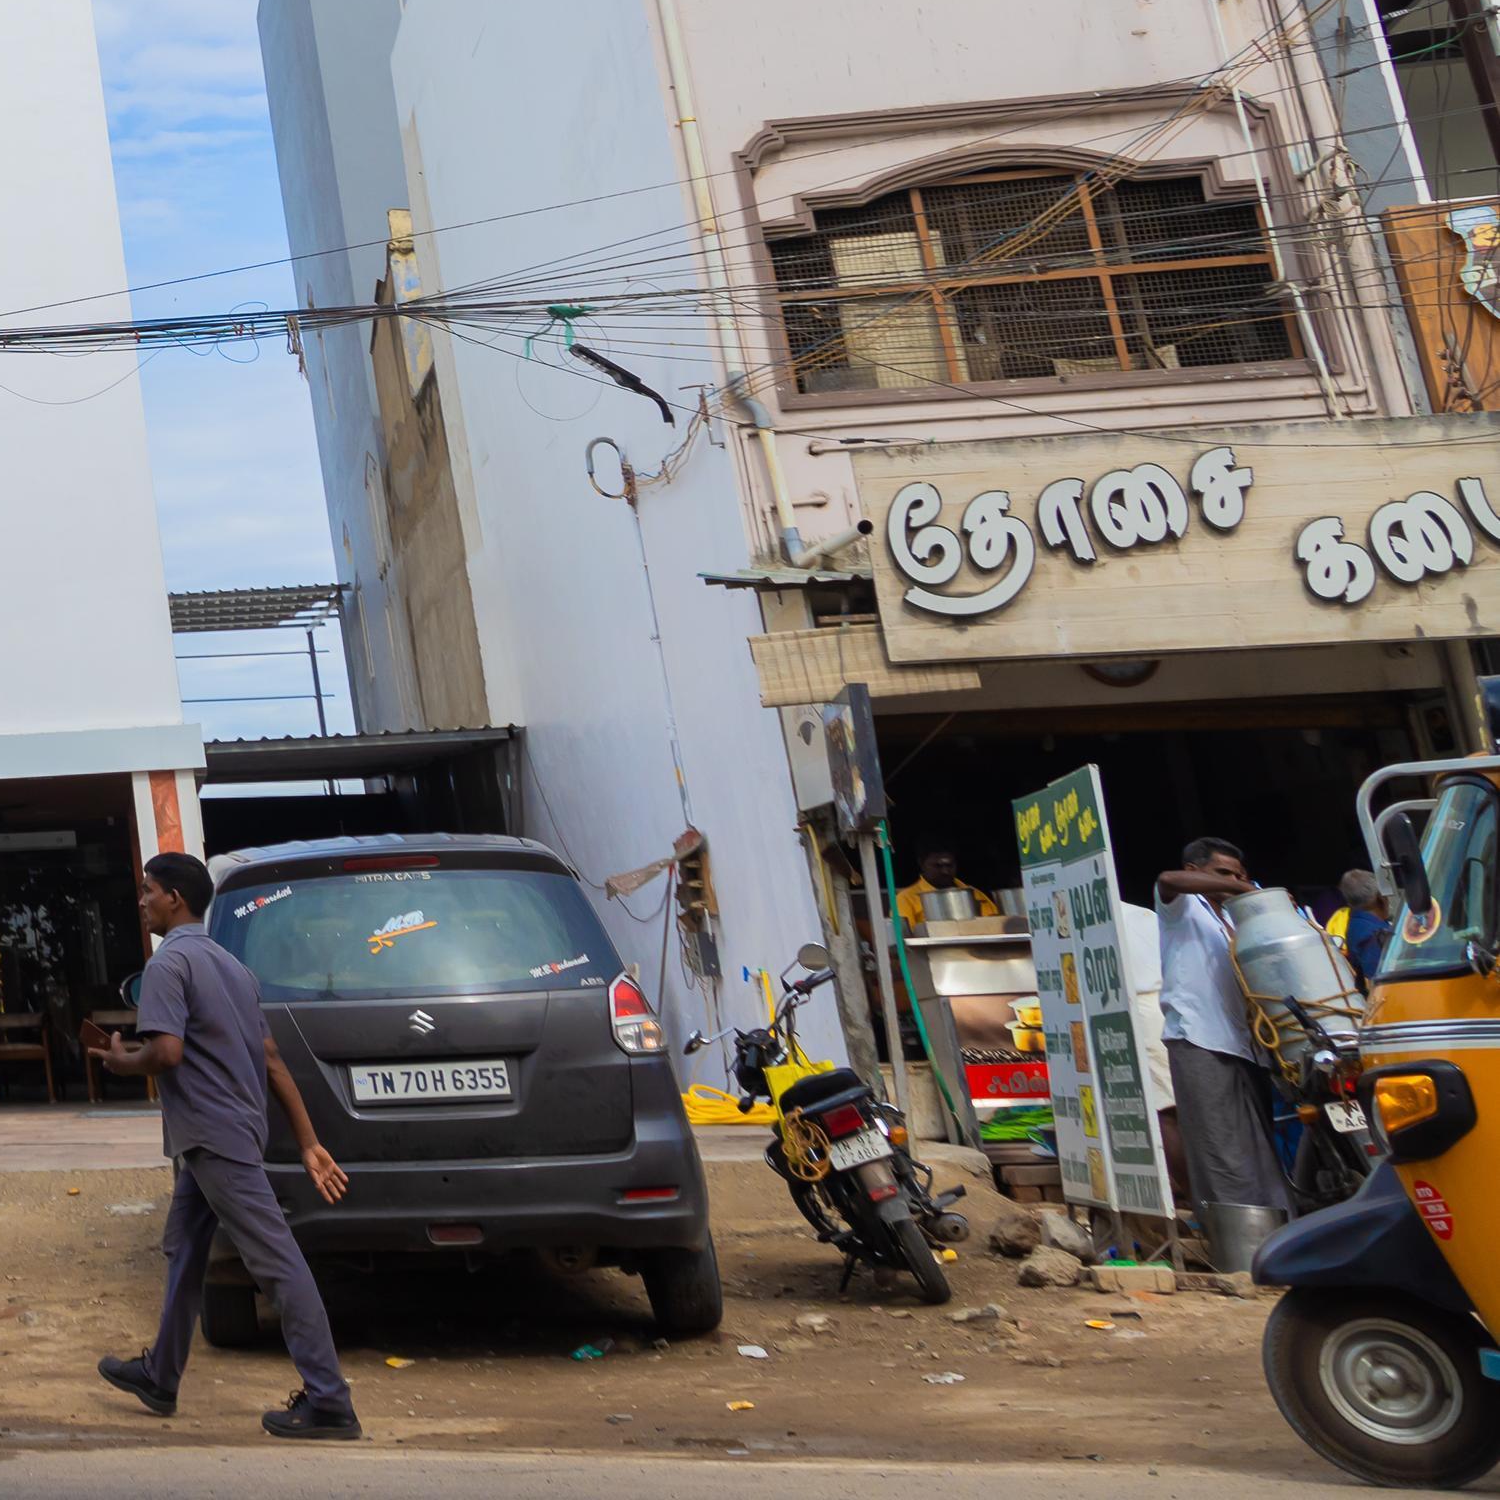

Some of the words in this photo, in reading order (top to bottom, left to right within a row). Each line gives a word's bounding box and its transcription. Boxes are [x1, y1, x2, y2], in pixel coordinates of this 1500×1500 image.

[887, 446, 1254, 616] தோசை
[1068, 859, 1113, 941] டிபன்
[367, 1071, 396, 1095] TN
[400, 1070, 428, 1093] 70
[431, 1069, 447, 1092] H
[451, 1067, 507, 1091] 6355
